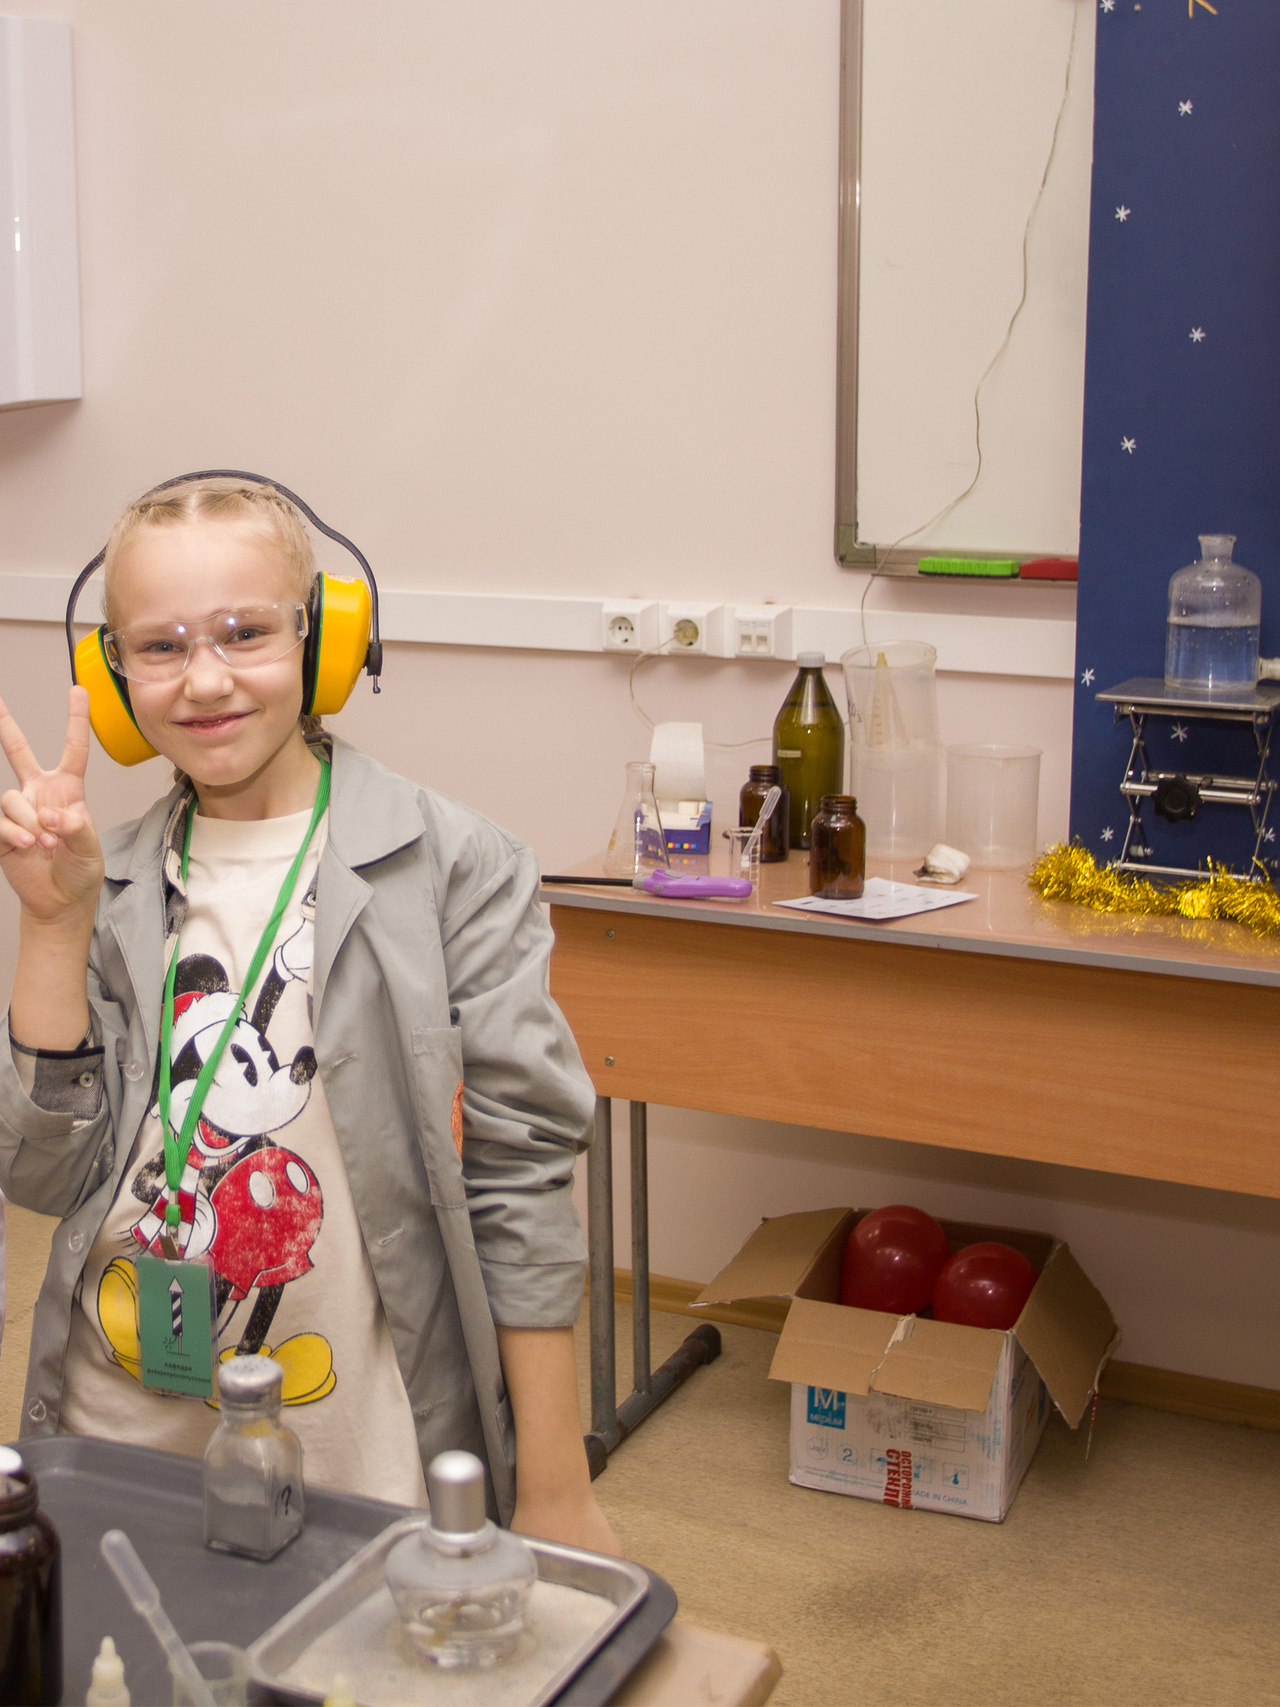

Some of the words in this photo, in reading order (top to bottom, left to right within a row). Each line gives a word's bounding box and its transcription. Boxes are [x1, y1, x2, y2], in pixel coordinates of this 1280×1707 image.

[809, 1413, 843, 1426] MEDIUM
[842, 1447, 854, 1463] 2
[912, 1489, 930, 1499] ADE
[943, 1494, 968, 1506] CHINA
